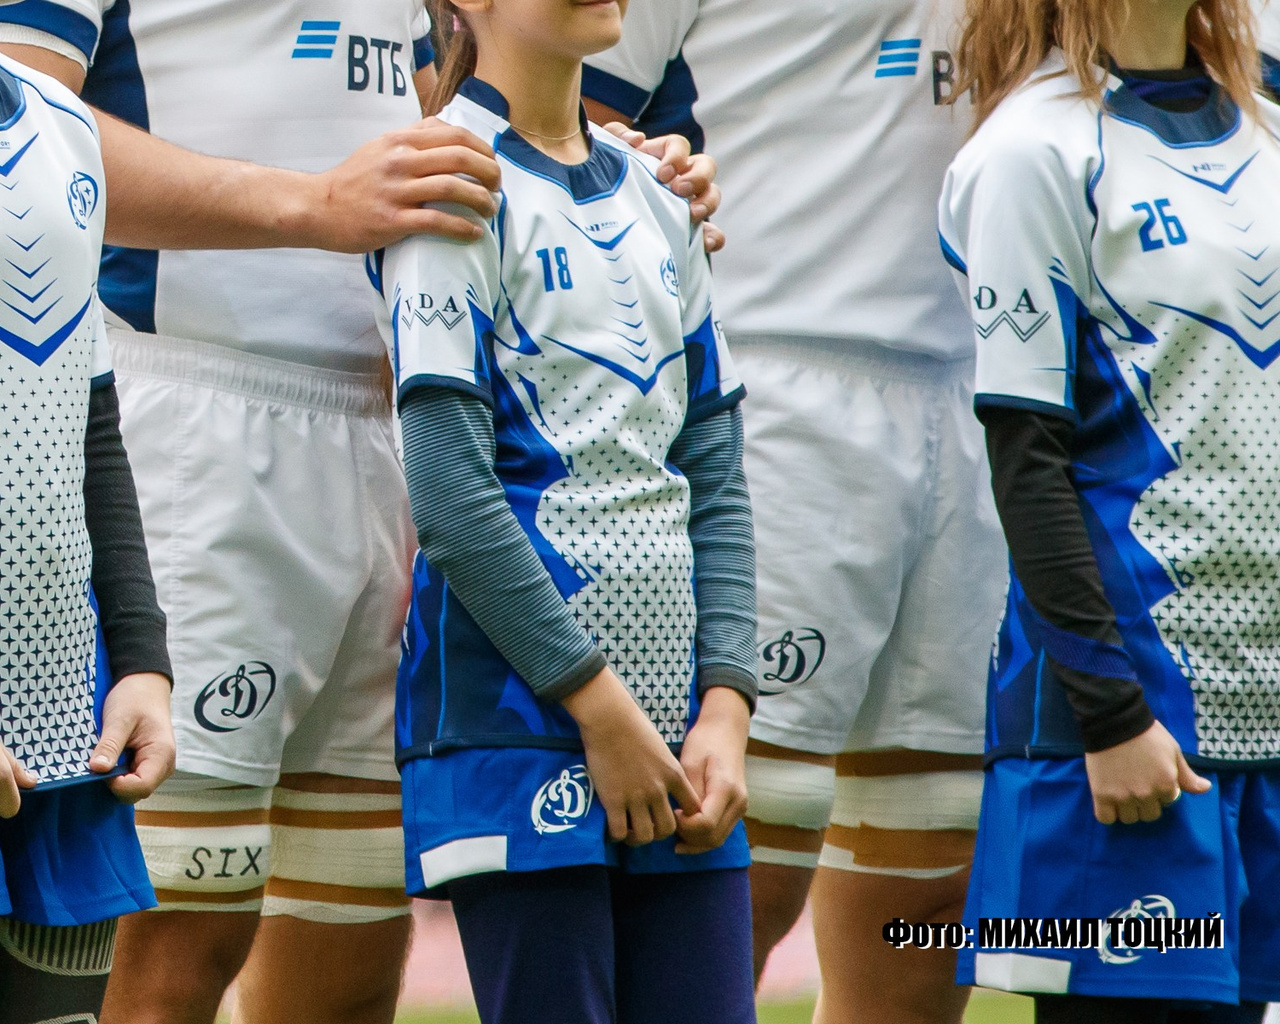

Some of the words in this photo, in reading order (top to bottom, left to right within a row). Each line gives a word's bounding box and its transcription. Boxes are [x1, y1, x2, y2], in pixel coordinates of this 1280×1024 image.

[1131, 198, 1188, 253] 26
[536, 246, 573, 292] 18
[185, 845, 263, 881] SIX
